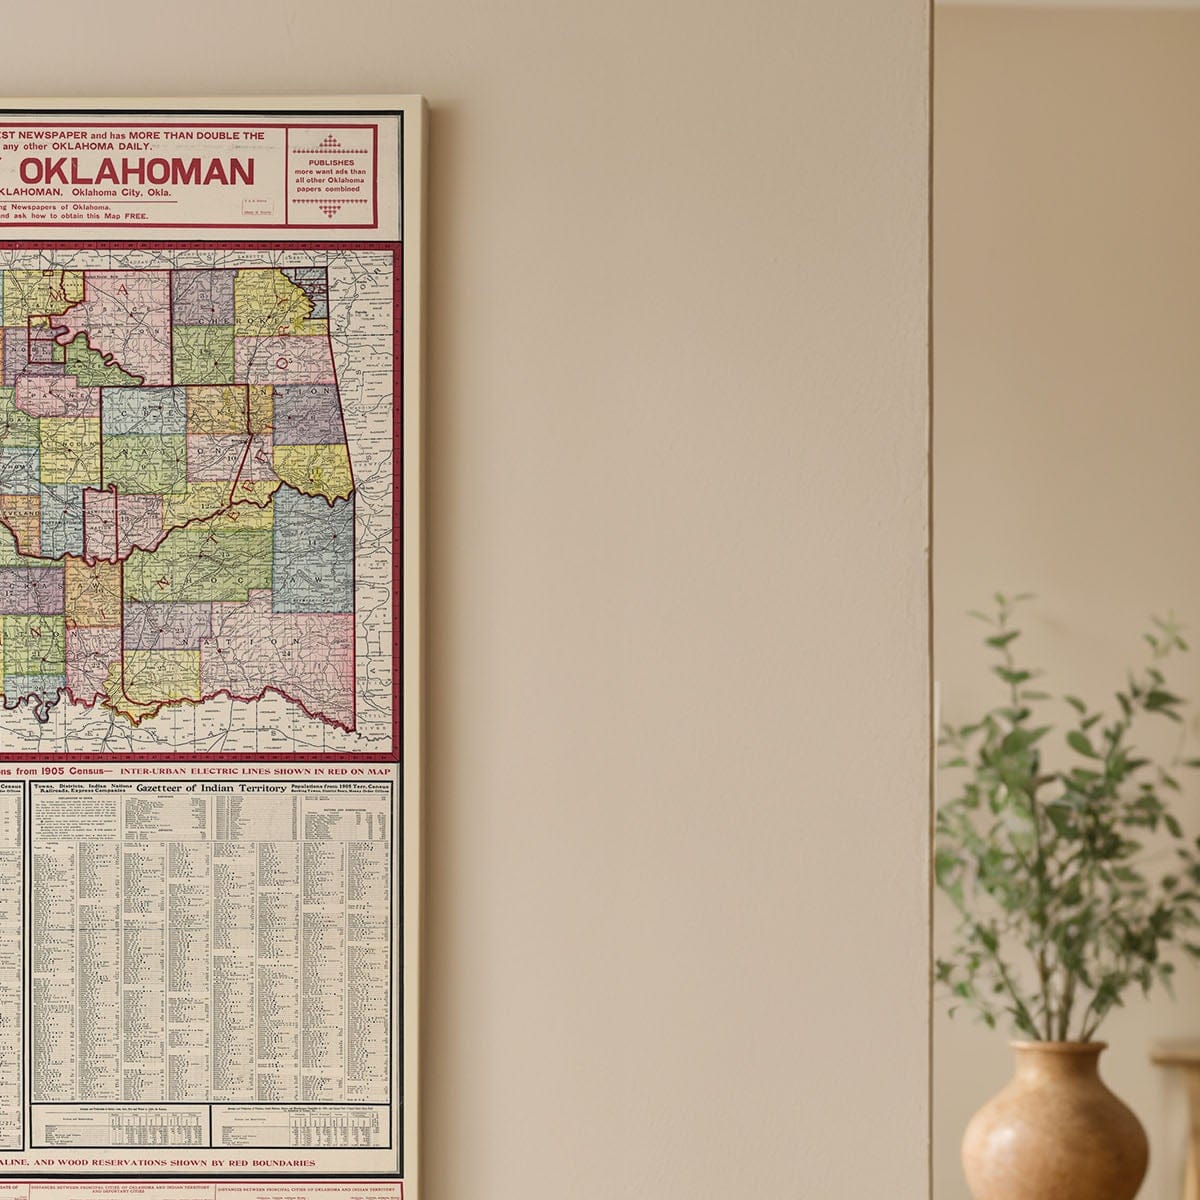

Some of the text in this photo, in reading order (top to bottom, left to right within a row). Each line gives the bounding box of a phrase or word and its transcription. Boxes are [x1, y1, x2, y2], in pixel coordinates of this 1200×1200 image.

[196, 132, 240, 140] DOUBLE
[243, 132, 264, 140] THE
[23, 142, 48, 150] other
[52, 142, 114, 150] OKLAHOMA
[20, 157, 254, 185] OKLAHOMAN
[72, 188, 117, 196] Oklahoma
[42, 767, 64, 775] 1905
[136, 784, 287, 794] Gazetteer of Indian Territory
